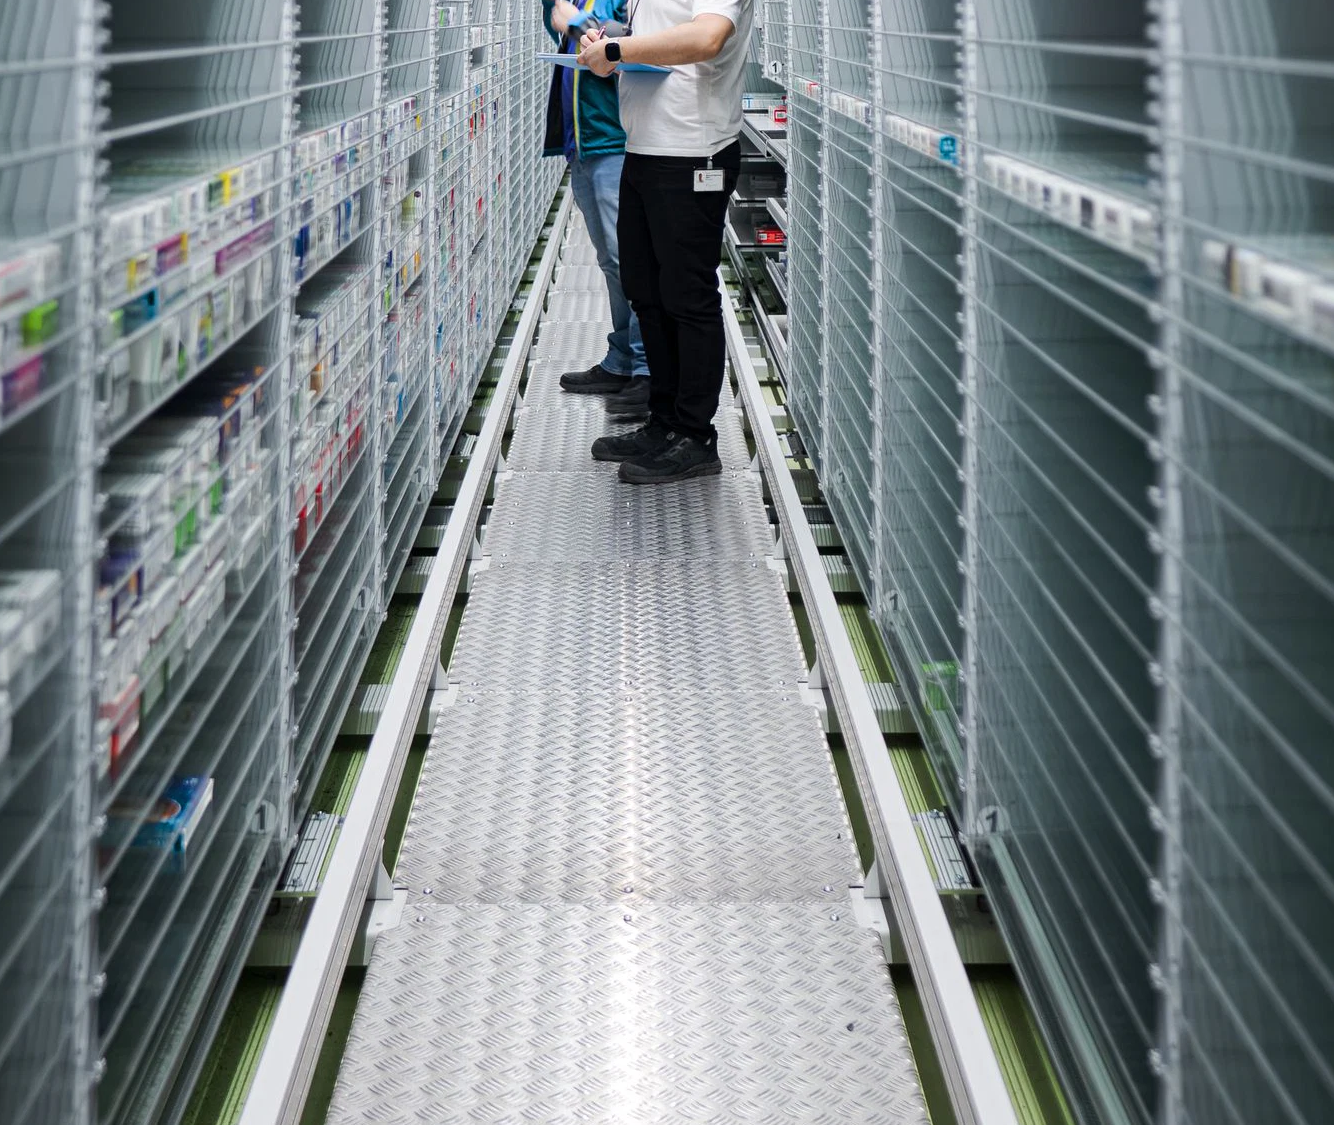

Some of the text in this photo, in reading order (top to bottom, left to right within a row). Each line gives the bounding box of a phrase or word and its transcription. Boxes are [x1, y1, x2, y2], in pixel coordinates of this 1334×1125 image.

[772, 62, 777, 73] 1
[889, 593, 898, 611] 1
[255, 804, 266, 830] 1
[985, 809, 997, 833] 1
